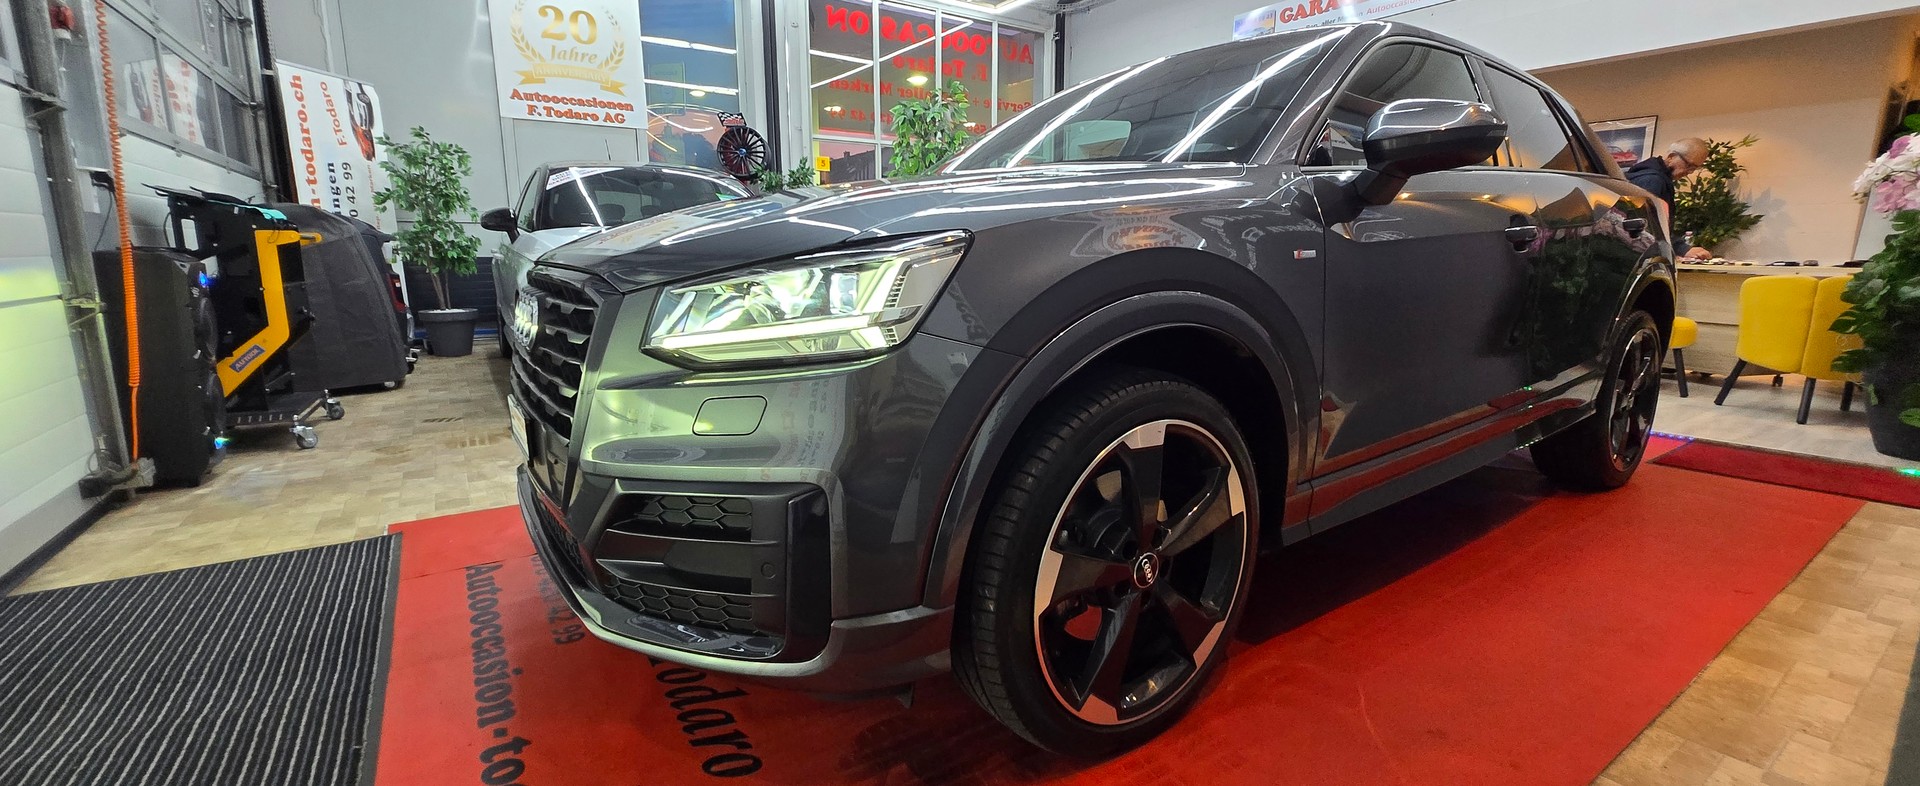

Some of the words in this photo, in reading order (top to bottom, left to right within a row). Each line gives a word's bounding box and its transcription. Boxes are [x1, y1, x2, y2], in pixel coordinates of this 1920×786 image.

[538, 5, 598, 45] 20
[550, 44, 598, 64] Jahre
[510, 88, 634, 112] Autooccasionen
[527, 104, 542, 117] F.
[543, 105, 600, 122] Todaro
[603, 112, 626, 124] AG
[341, 162, 353, 180] 99
[345, 186, 356, 204] 42
[465, 563, 532, 786] Autooccasion-to
[648, 656, 763, 778] odaro
